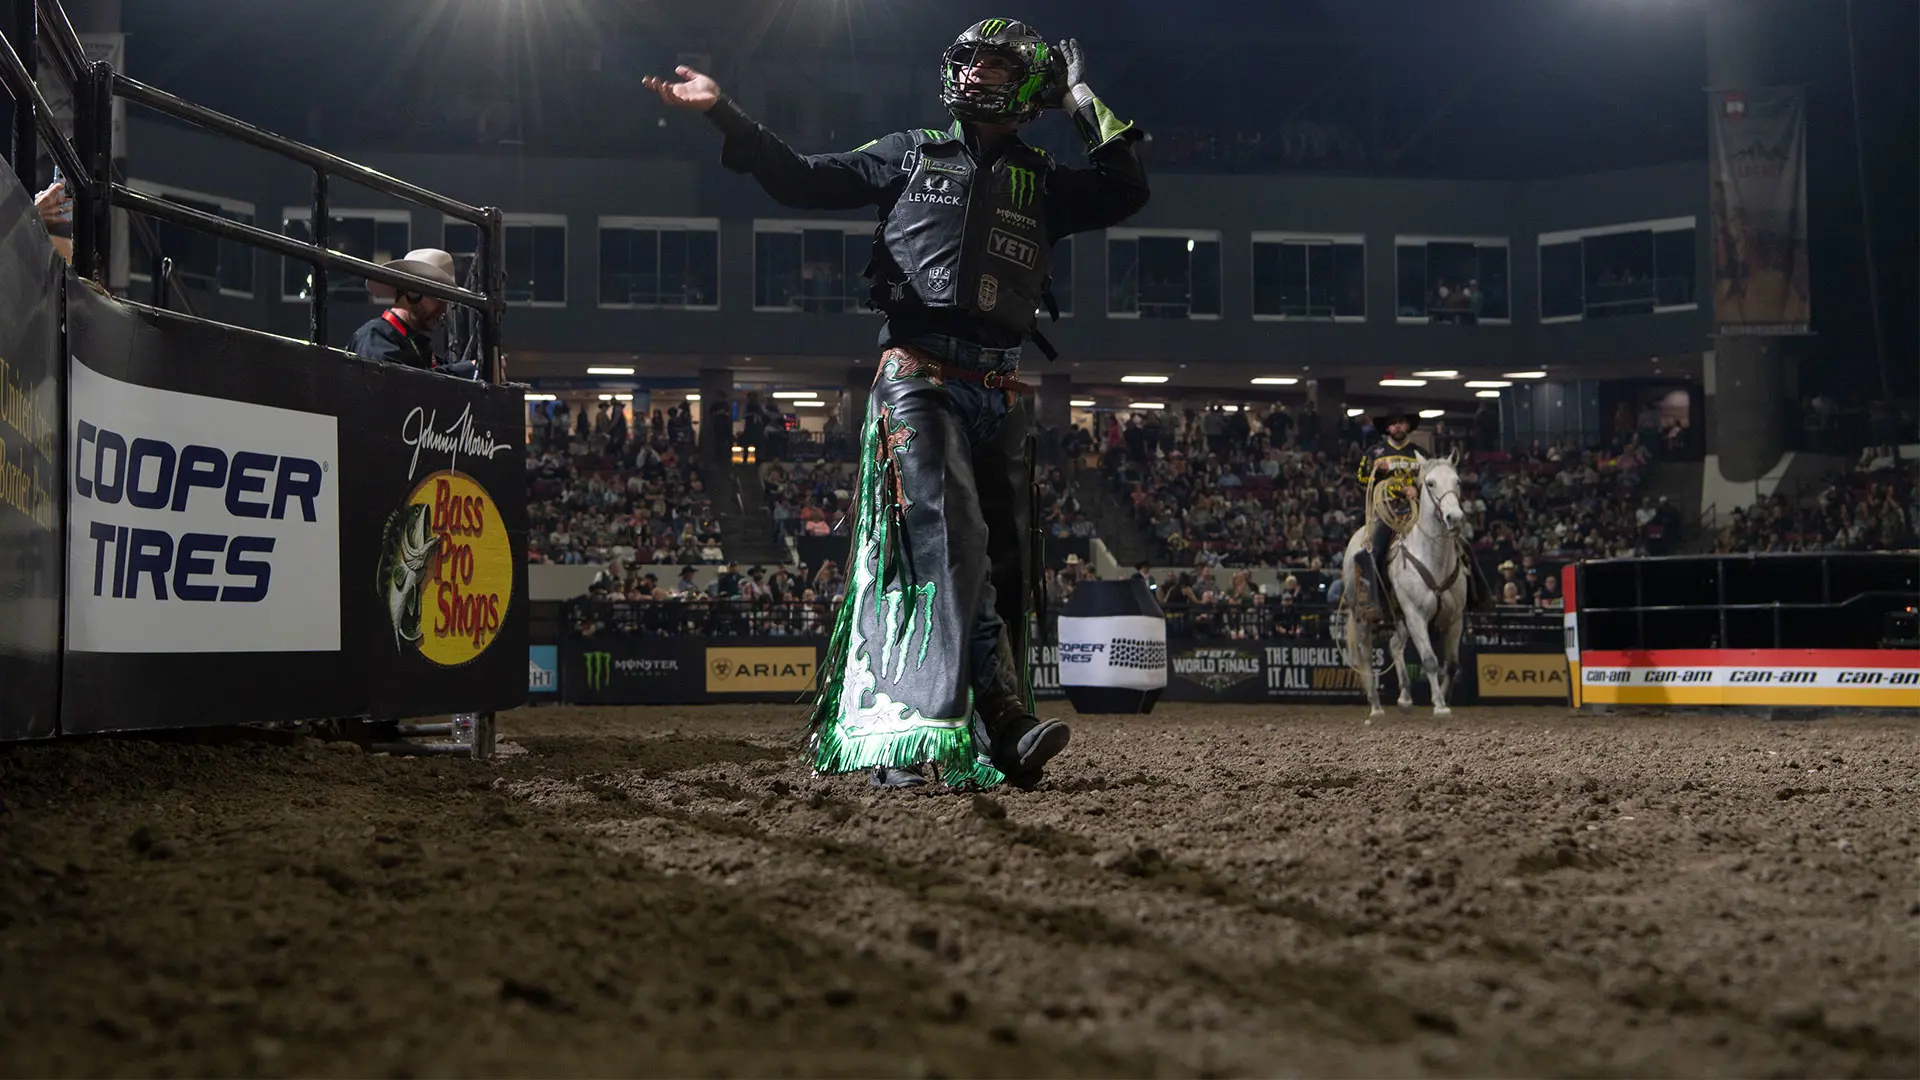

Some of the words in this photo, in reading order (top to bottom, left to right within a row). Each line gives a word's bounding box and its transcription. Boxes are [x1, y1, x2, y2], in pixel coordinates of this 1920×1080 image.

[993, 234, 1035, 263] YETI
[75, 418, 323, 522] COOPER
[431, 478, 484, 538] Bass
[89, 521, 276, 602] TIRES
[433, 531, 474, 586] Pro
[433, 580, 500, 647] Shops
[614, 658, 679, 671] MONSTER
[1172, 658, 1216, 673] WORLD
[1218, 658, 1260, 673] FINALS
[1265, 647, 1289, 665] THE
[1291, 647, 1340, 666] BUCKLE
[734, 663, 812, 677] ARIAT
[1033, 666, 1060, 688] ALL
[1268, 667, 1283, 688] IT
[1284, 667, 1309, 688] ALL
[1504, 669, 1567, 683] ARIA
[1586, 669, 1631, 683] can-am
[1643, 669, 1713, 683] can-am
[1728, 669, 1818, 684] can-am
